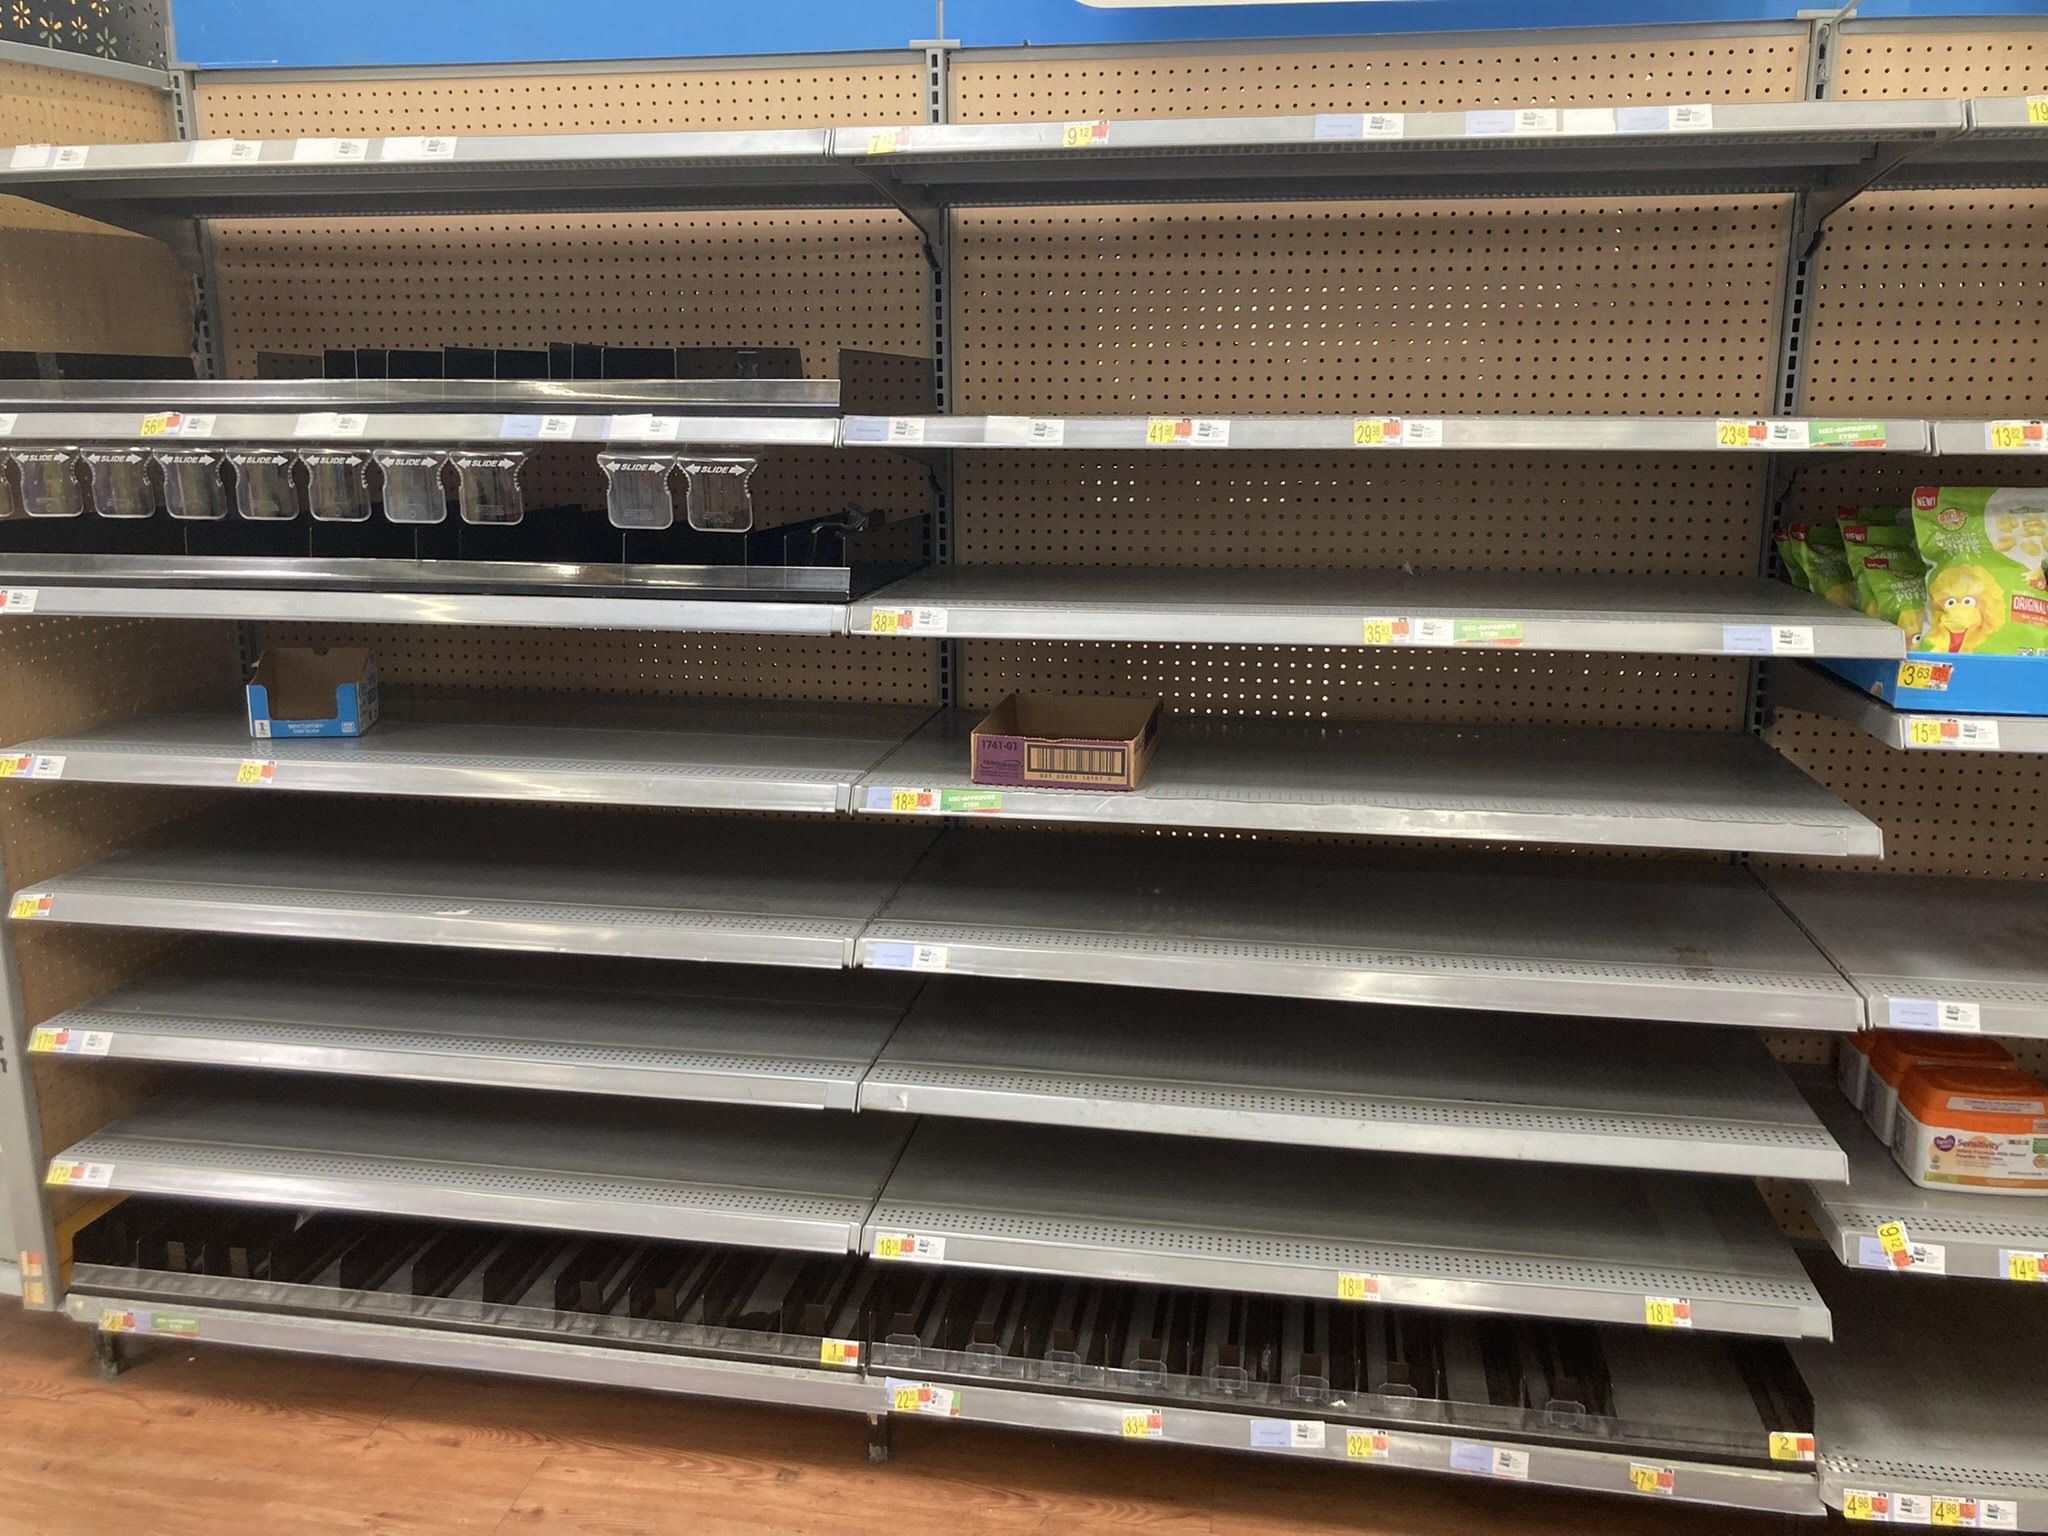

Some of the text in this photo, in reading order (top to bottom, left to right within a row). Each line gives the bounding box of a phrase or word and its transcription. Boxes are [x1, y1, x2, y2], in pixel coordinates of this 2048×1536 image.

[29, 454, 54, 462] SLIDE
[173, 456, 199, 464] SLIDE
[246, 456, 272, 464] SLIDE
[320, 456, 346, 464] SLIDE
[395, 458, 421, 466] SLIDE
[471, 459, 498, 467] SLIDE
[620, 463, 646, 471] SLIDE
[700, 465, 728, 473] SLIDE
[1916, 497, 1937, 506] NEW!
[2013, 595, 2048, 615] ORIGINAL
[981, 739, 1018, 751] 1741-01
[1780, 1436, 1789, 1450] 2
